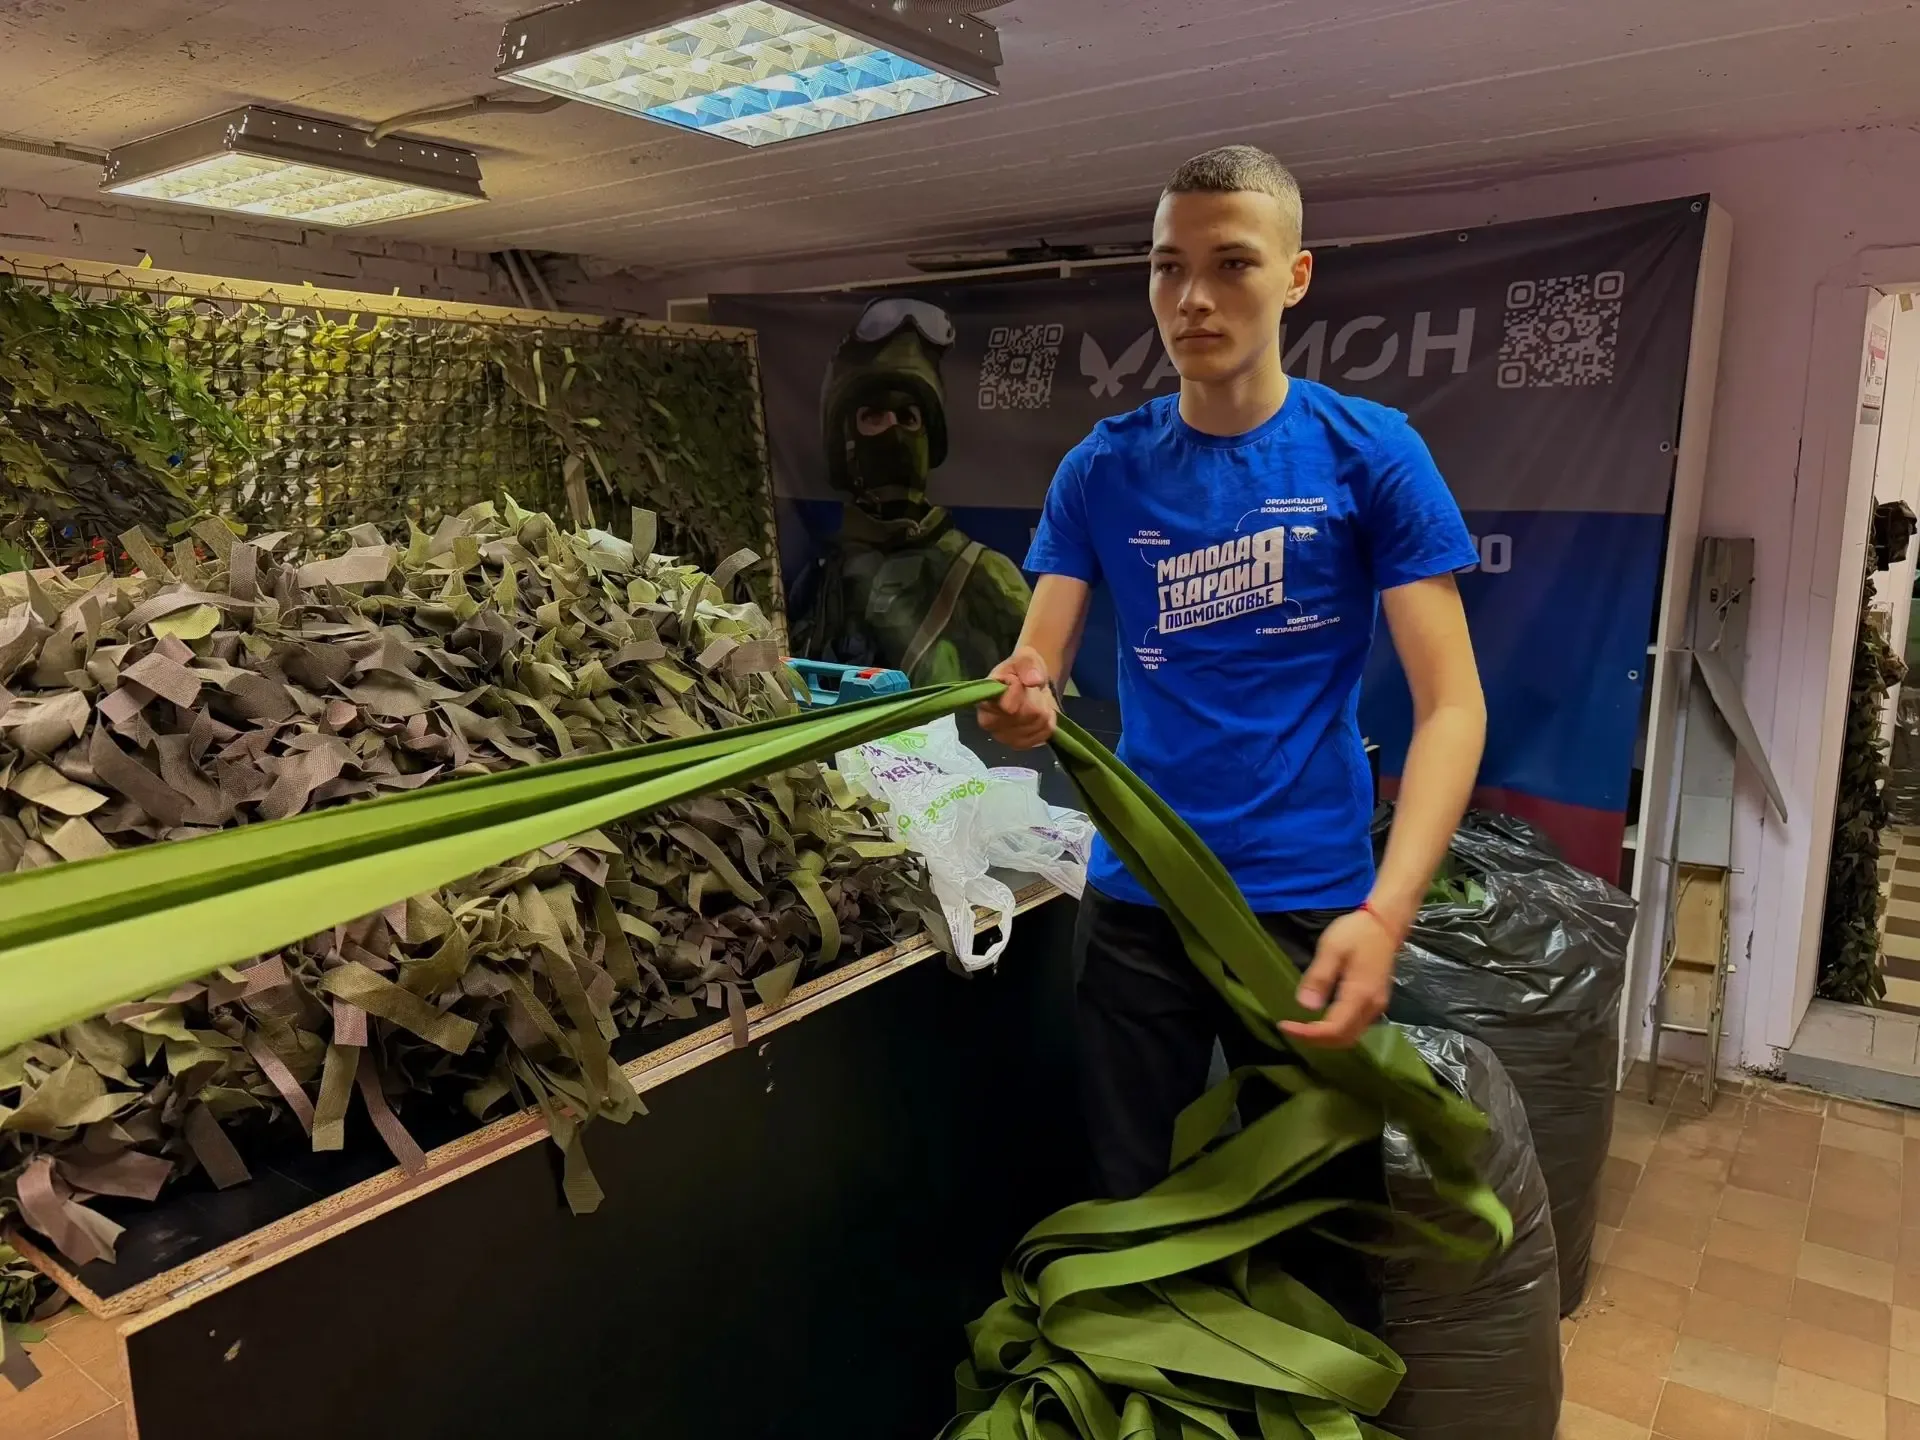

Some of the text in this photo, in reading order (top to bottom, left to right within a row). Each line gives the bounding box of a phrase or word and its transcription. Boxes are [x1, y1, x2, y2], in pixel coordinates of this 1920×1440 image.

[1143, 308, 1476, 390] ИОН
[1265, 497, 1324, 506] ОРГАНИЗАЦИЯ
[1260, 504, 1328, 514] ВОЗМОЖНОСТЕЙ
[1128, 537, 1171, 546] ПОКОЛЕНИЯ
[1165, 588, 1275, 630] ПОДМОСКОВЬЕ
[1286, 614, 1319, 625] БОРЕТСЯ
[1255, 627, 1262, 635] С
